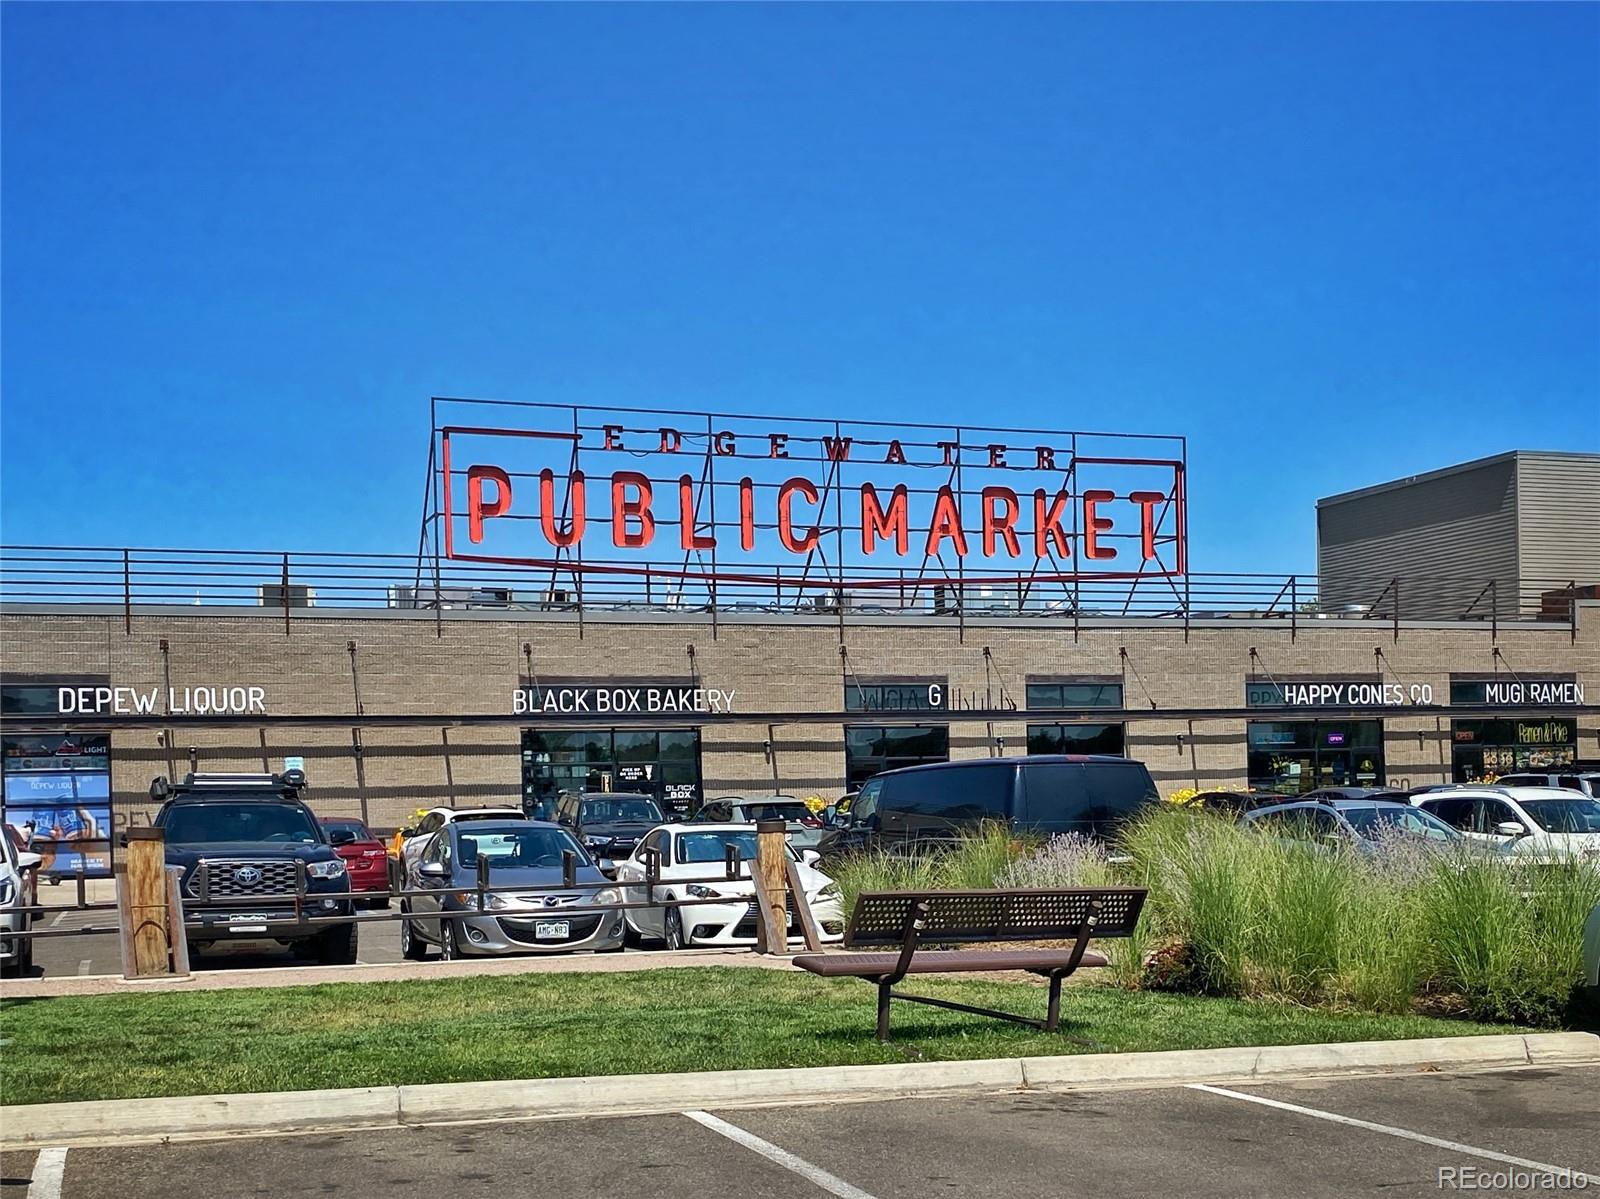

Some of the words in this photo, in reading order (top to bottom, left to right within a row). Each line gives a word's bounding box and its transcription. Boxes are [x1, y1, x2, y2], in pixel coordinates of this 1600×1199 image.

[602, 425, 1056, 470] EDGEWATER
[467, 464, 819, 553] PUBLIC
[860, 482, 1165, 560] MARKET
[58, 688, 157, 713] DEPEW
[169, 687, 266, 714] LIQUOR
[512, 689, 589, 714] BLACK
[596, 688, 641, 712] BOX
[647, 689, 736, 713] BAKERY
[1284, 685, 1344, 706] HAPPY
[1347, 684, 1404, 705] CONES
[1485, 683, 1525, 704] MUGI
[1530, 682, 1584, 704] RAMEN
[1456, 731, 1473, 740] OPEN
[1518, 723, 1543, 743] Ramen
[84, 746, 107, 754] LIGHT
[665, 784, 696, 792] BLACK
[670, 791, 691, 799] BOX
